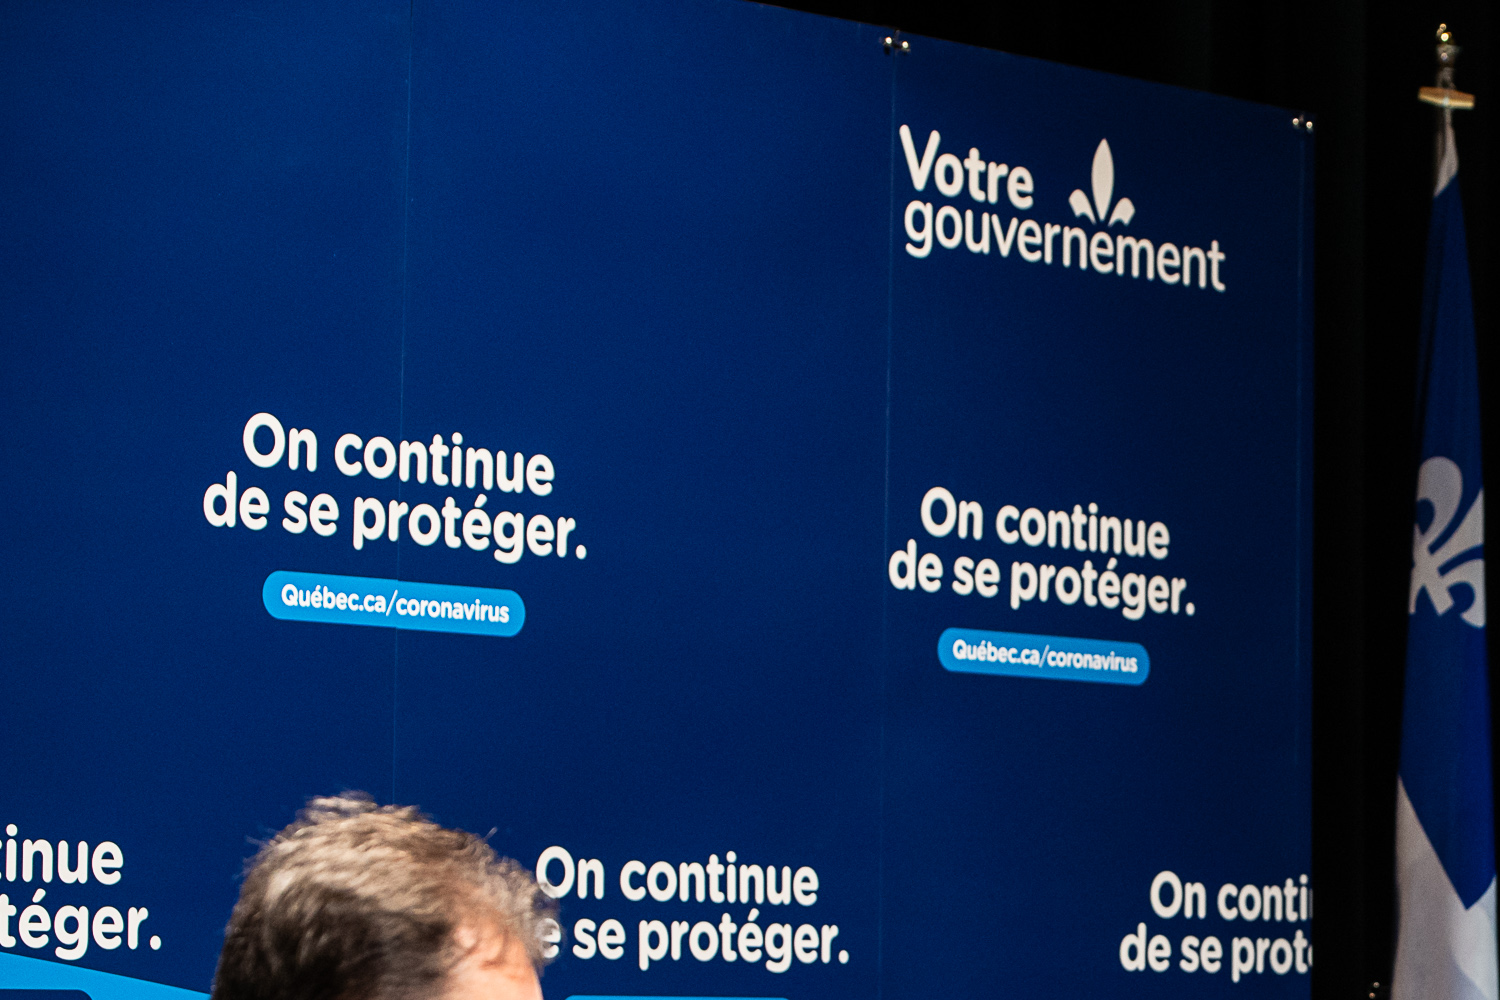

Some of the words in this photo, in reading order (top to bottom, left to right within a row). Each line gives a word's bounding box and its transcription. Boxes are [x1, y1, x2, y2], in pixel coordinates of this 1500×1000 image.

[899, 124, 1034, 209] Votre
[904, 200, 1226, 292] gouvernement
[243, 412, 318, 471] On
[334, 432, 555, 497] continue
[203, 471, 268, 530] de
[282, 491, 339, 537] se
[352, 494, 587, 563] protéger.
[920, 486, 983, 540] On
[996, 504, 1170, 560] continue
[280, 583, 510, 624] Québec.ca/coronavirus
[888, 539, 941, 593] de
[952, 556, 1000, 598] se
[1010, 558, 1195, 620] protéger.
[952, 638, 1138, 673] Québec.ca/coronavirus
[0, 824, 124, 885] inue
[536, 845, 605, 900] On
[620, 851, 819, 906] continue
[1150, 870, 1207, 919] On
[1217, 874, 1313, 923] conti
[573, 918, 626, 960] se
[639, 908, 849, 974] protéger.
[1119, 922, 1172, 973] de
[1180, 935, 1223, 973] se
[1232, 929, 1313, 983] prot
